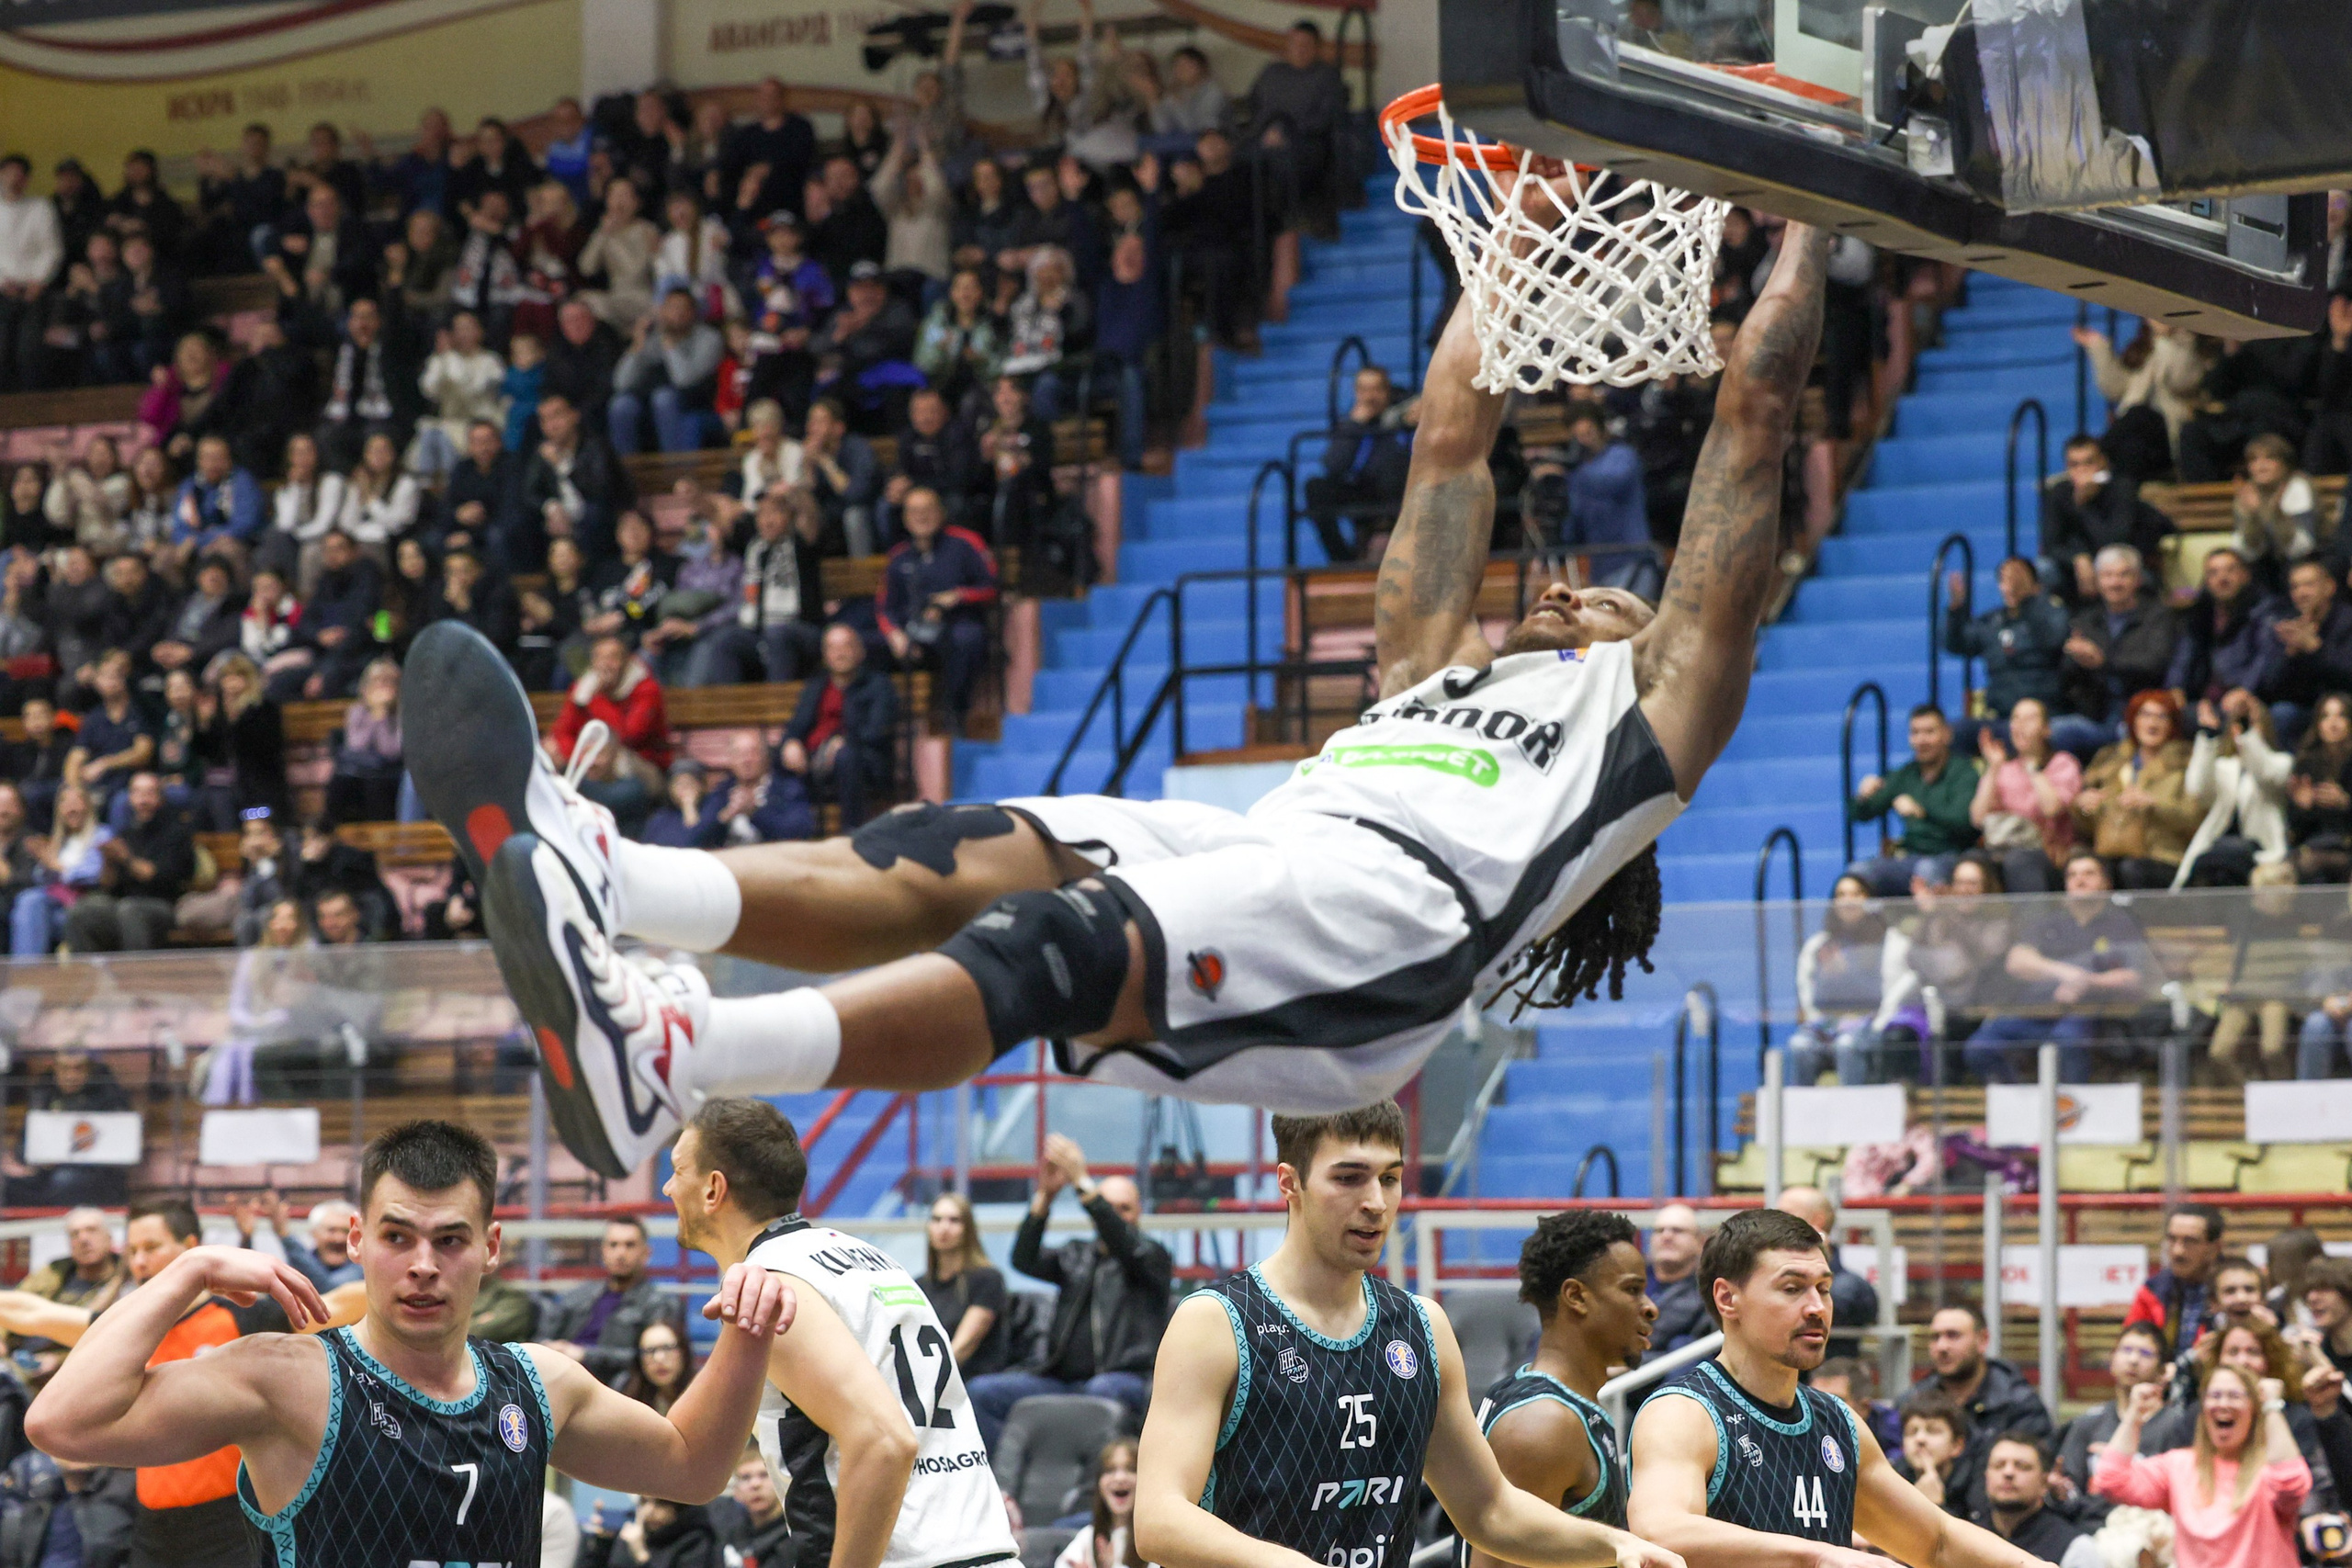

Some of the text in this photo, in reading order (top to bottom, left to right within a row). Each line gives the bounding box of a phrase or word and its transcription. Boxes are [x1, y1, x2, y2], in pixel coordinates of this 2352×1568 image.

[889, 1324, 956, 1429] 12
[1338, 1393, 1376, 1450] 25
[451, 1463, 479, 1526] 7
[1793, 1475, 1827, 1528] 44
